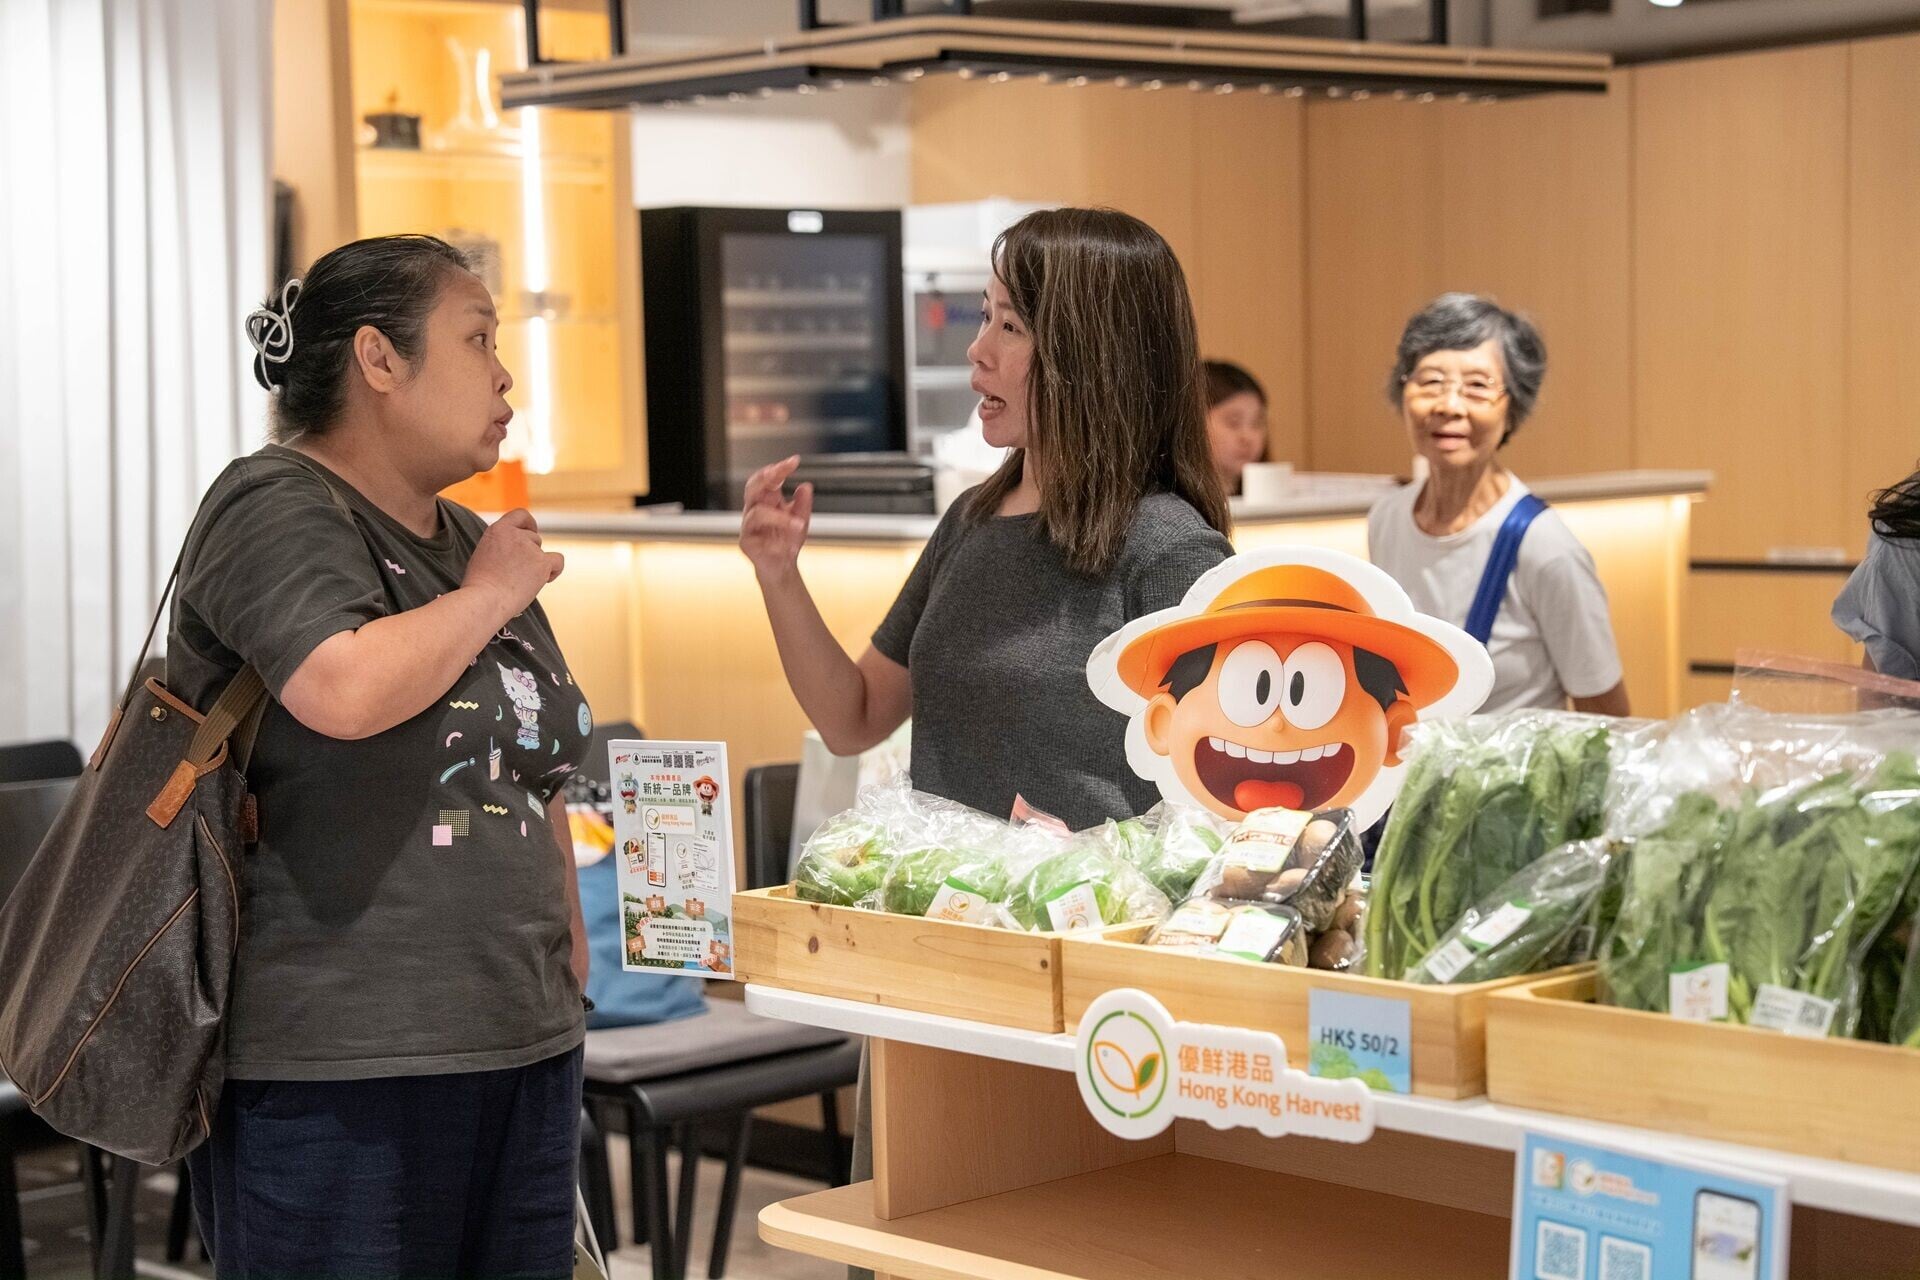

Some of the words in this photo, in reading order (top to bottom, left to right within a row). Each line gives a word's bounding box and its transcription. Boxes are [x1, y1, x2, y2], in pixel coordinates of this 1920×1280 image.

[643, 783, 691, 796] 新統一品牌
[1320, 1026, 1356, 1050] HK$
[1360, 1033, 1399, 1058] 50/2
[1178, 1044, 1274, 1084] 優鮮港品
[1178, 1077, 1228, 1109] Hong
[1232, 1084, 1281, 1117] Kong
[1286, 1092, 1361, 1122] Harvest
